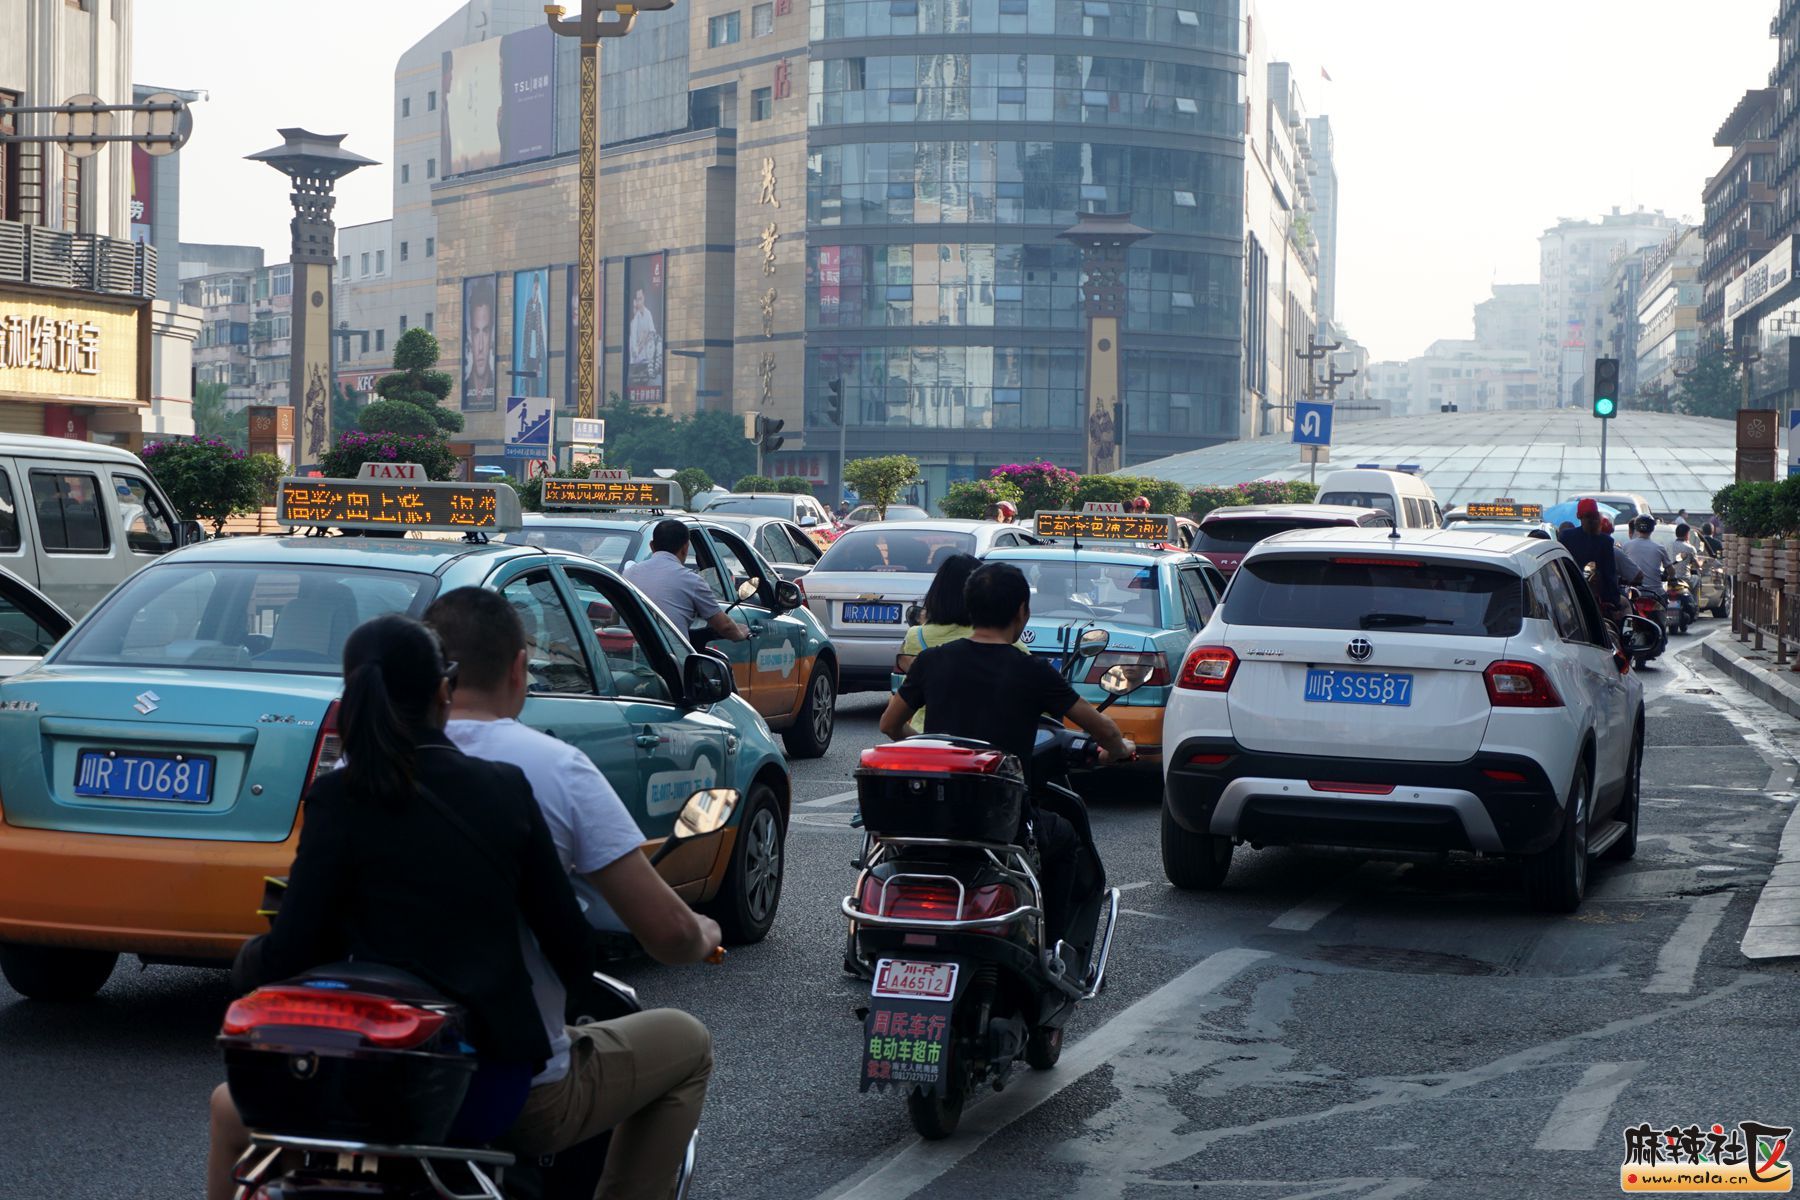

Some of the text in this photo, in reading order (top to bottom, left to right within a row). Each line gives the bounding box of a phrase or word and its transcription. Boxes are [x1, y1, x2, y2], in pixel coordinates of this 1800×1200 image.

[356, 375, 374, 391] KFC
[367, 464, 415, 479] TAXI
[593, 470, 622, 479] TAXI
[1087, 503, 1118, 513] TAXI
[1308, 675, 1410, 701] 川R·SS587
[891, 976, 943, 991] A46512
[871, 1010, 946, 1041] 周氏车行
[869, 1036, 942, 1064] 电动车超市
